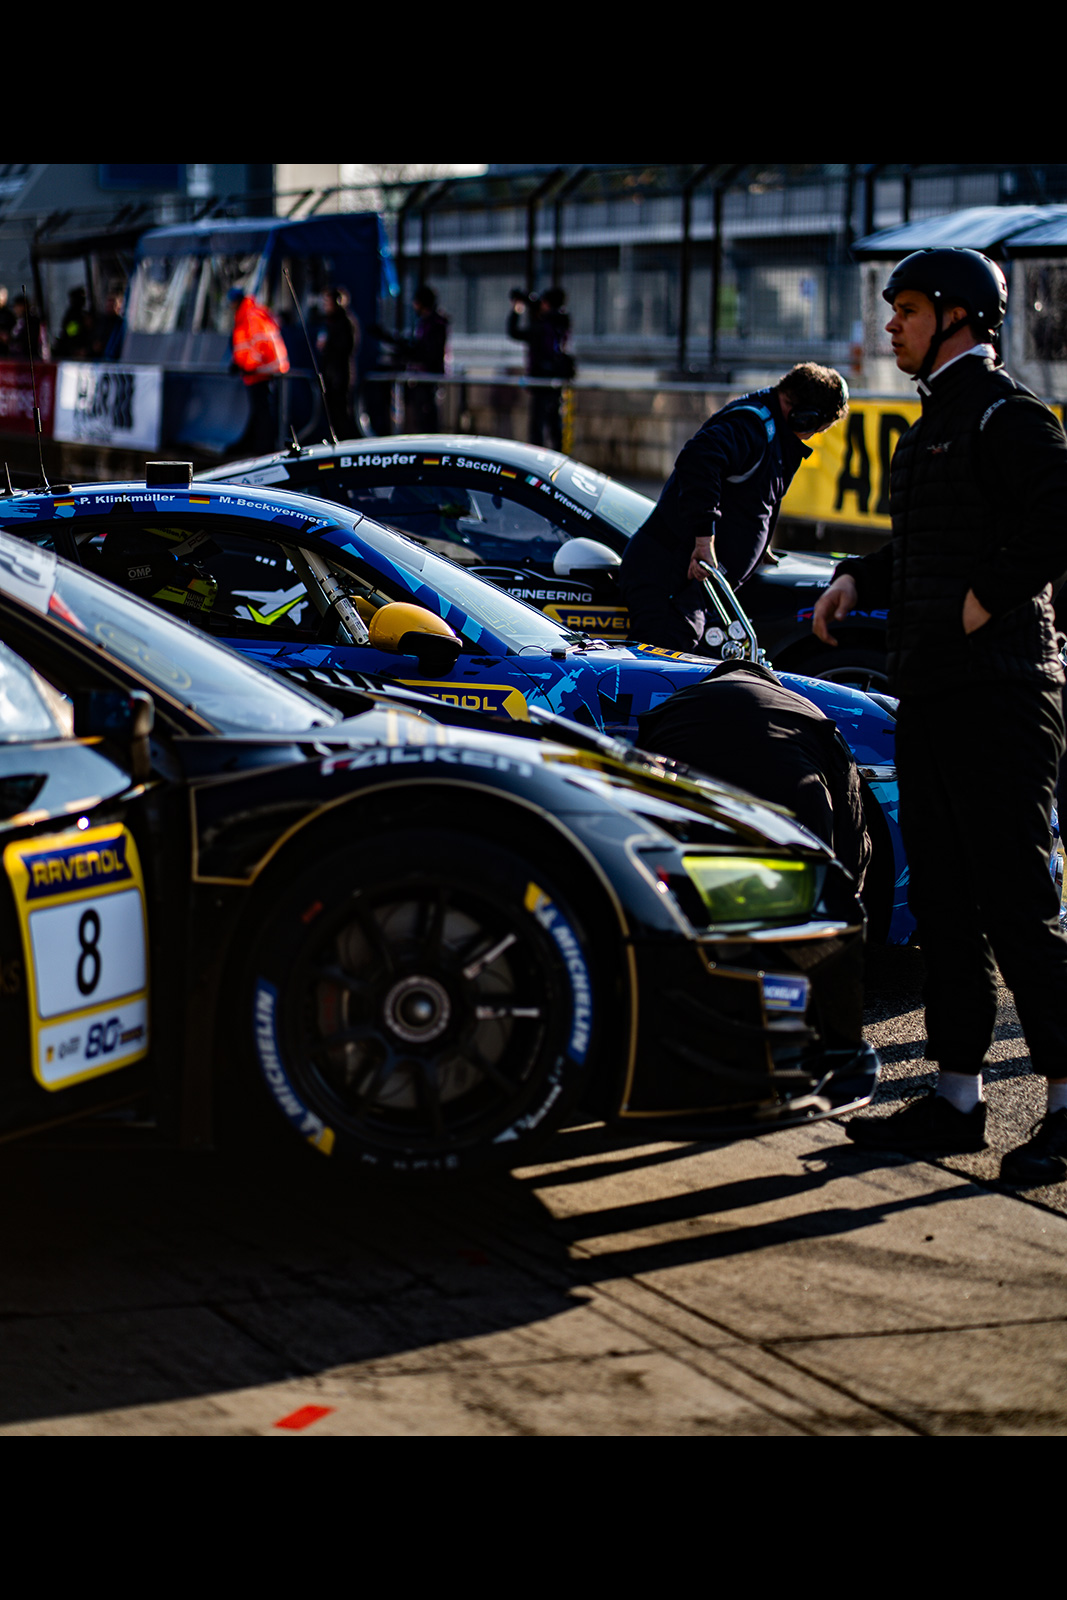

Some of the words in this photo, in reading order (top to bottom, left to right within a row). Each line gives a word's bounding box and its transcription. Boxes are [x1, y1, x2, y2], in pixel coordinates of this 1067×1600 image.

[441, 456, 452, 466] F.
[456, 457, 501, 475] Sacchi
[80, 497, 91, 505] P.
[95, 494, 176, 504] Klinkmüller
[539, 483, 551, 495] M.
[553, 491, 593, 521] Vitonelli
[128, 567, 152, 579] OMP
[320, 747, 533, 777] FALKEN
[31, 849, 125, 888] RAVENOL
[77, 908, 101, 996] 8
[552, 925, 592, 1055] MICHELIN
[84, 1016, 121, 1060] 80
[254, 988, 306, 1118] MICHELIN
